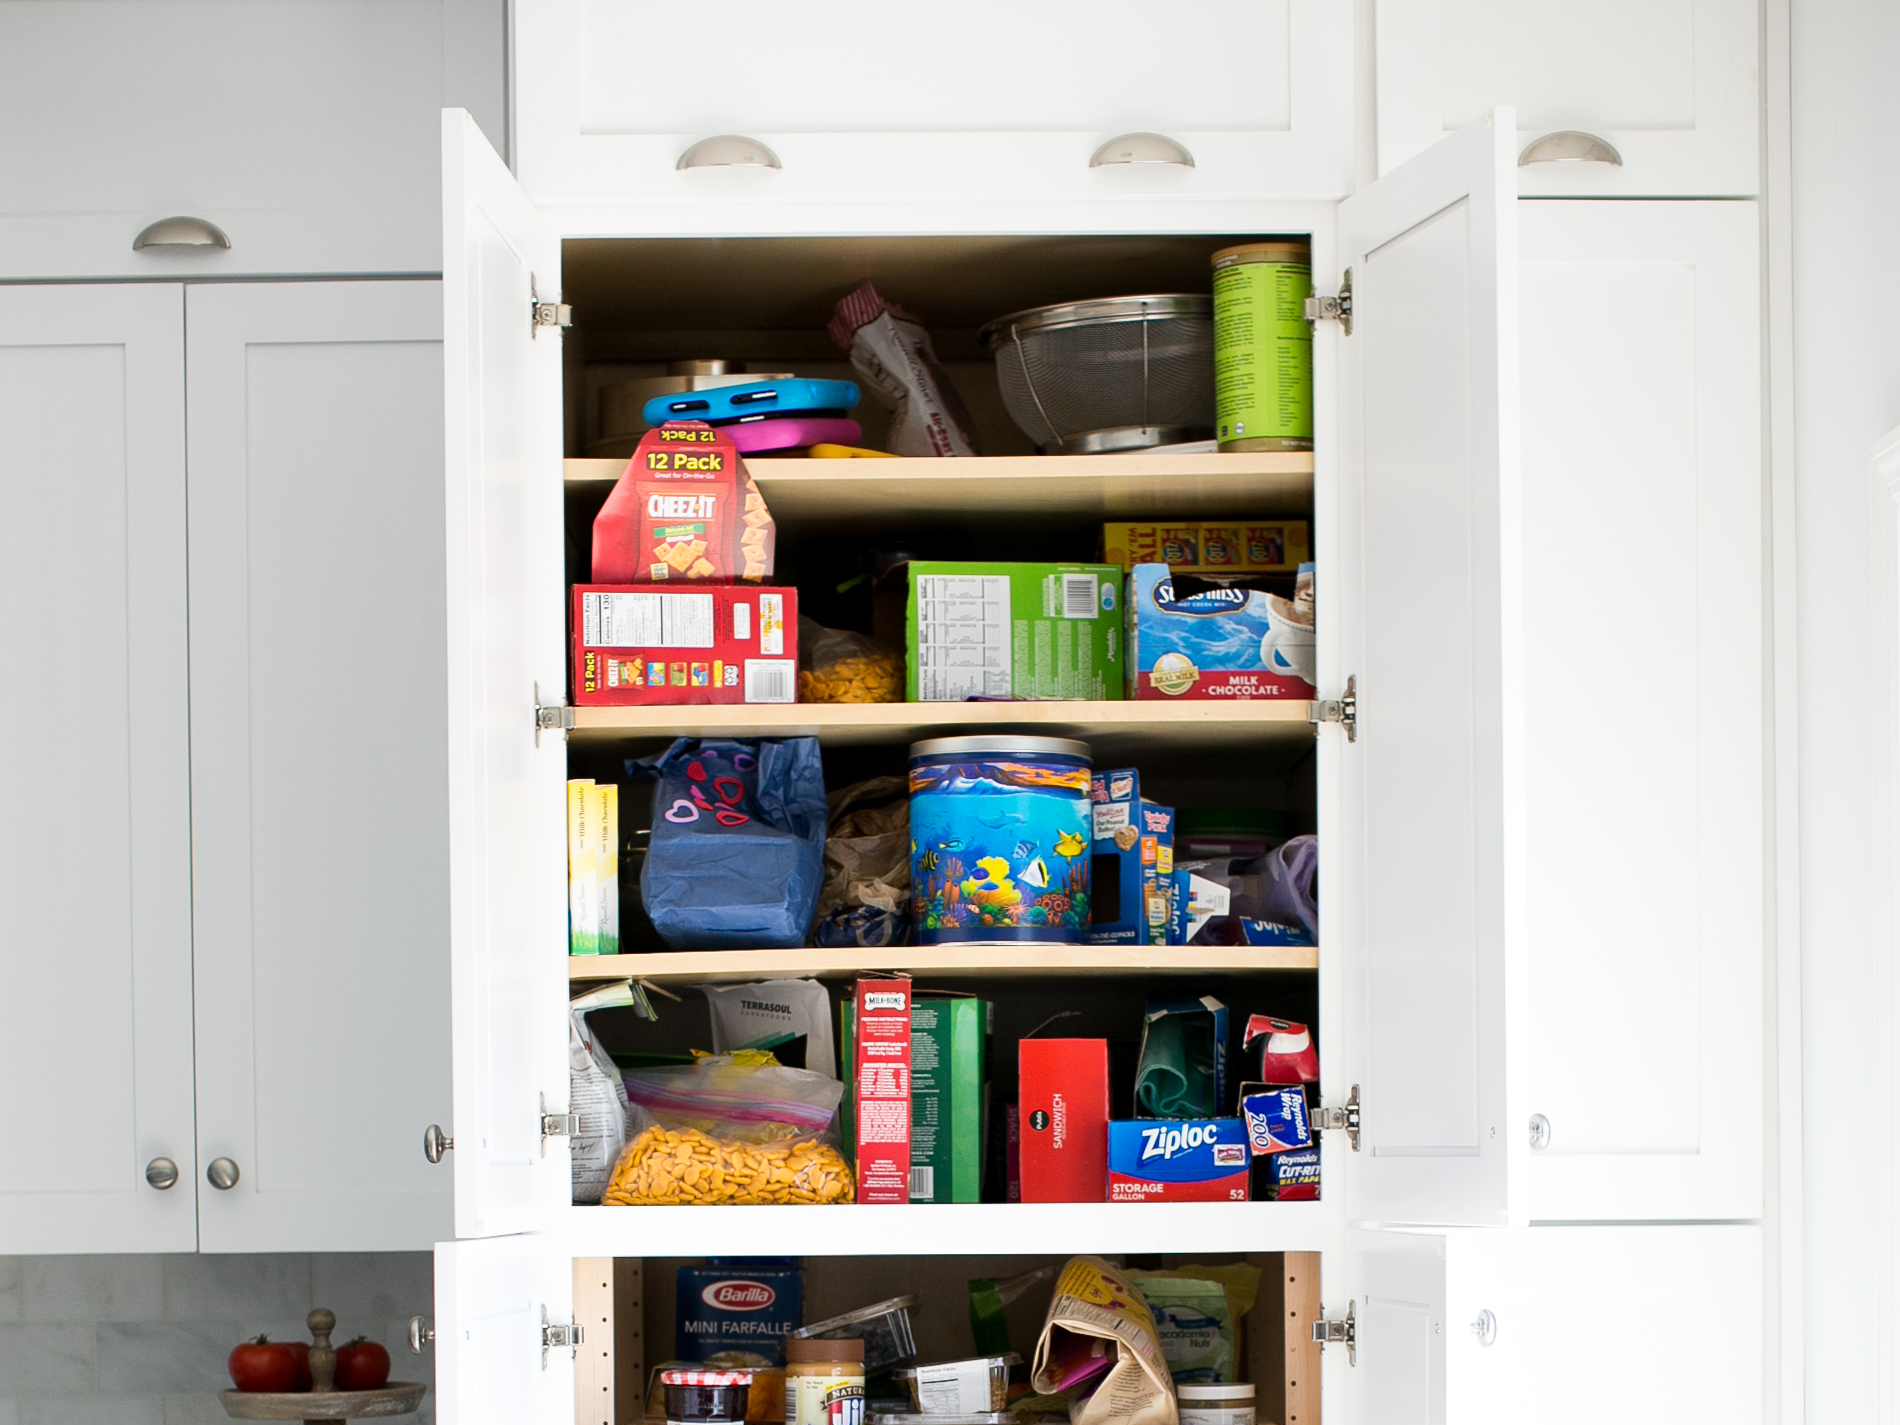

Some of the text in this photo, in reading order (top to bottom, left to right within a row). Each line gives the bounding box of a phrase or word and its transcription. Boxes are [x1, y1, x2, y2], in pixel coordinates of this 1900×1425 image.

[661, 430, 716, 442] 12 Pack
[648, 453, 722, 470] 12 Pack
[648, 494, 717, 519] CHEEZ-IT
[1139, 528, 1157, 563] ALL
[1166, 540, 1182, 562] RITZ
[584, 652, 595, 693] 12 Pack
[1154, 671, 1196, 685] REAL MILK
[1229, 676, 1258, 685] MILK
[1208, 686, 1278, 696] CHOCOLATE
[578, 787, 586, 819] Chocolate
[1144, 810, 1170, 824] Variety
[578, 820, 586, 838] Milk
[1147, 822, 1168, 832] Pack
[740, 1000, 792, 1014] TERRASOUL
[868, 996, 902, 1006] MILK-BONE
[1280, 1092, 1292, 1120] Wrap
[1053, 1094, 1062, 1149] SANDWICH
[1291, 1093, 1308, 1140] Reynolds
[1009, 1107, 1018, 1142] SNACK
[1249, 1112, 1271, 1149] 200
[1142, 1123, 1218, 1160] Ziploc
[1277, 1154, 1318, 1165] Reynolds
[1279, 1165, 1320, 1178] CUT-RIT
[1280, 1176, 1320, 1186] WAX PAPE
[1112, 1184, 1164, 1194] STORAGE
[1230, 1189, 1244, 1200] 52
[720, 1287, 770, 1302] Barilla
[684, 1321, 792, 1334] MINI FARFALLE
[1159, 1330, 1210, 1339] acadamia
[1190, 1339, 1210, 1348] Nuts
[832, 1386, 865, 1398] NATUR
